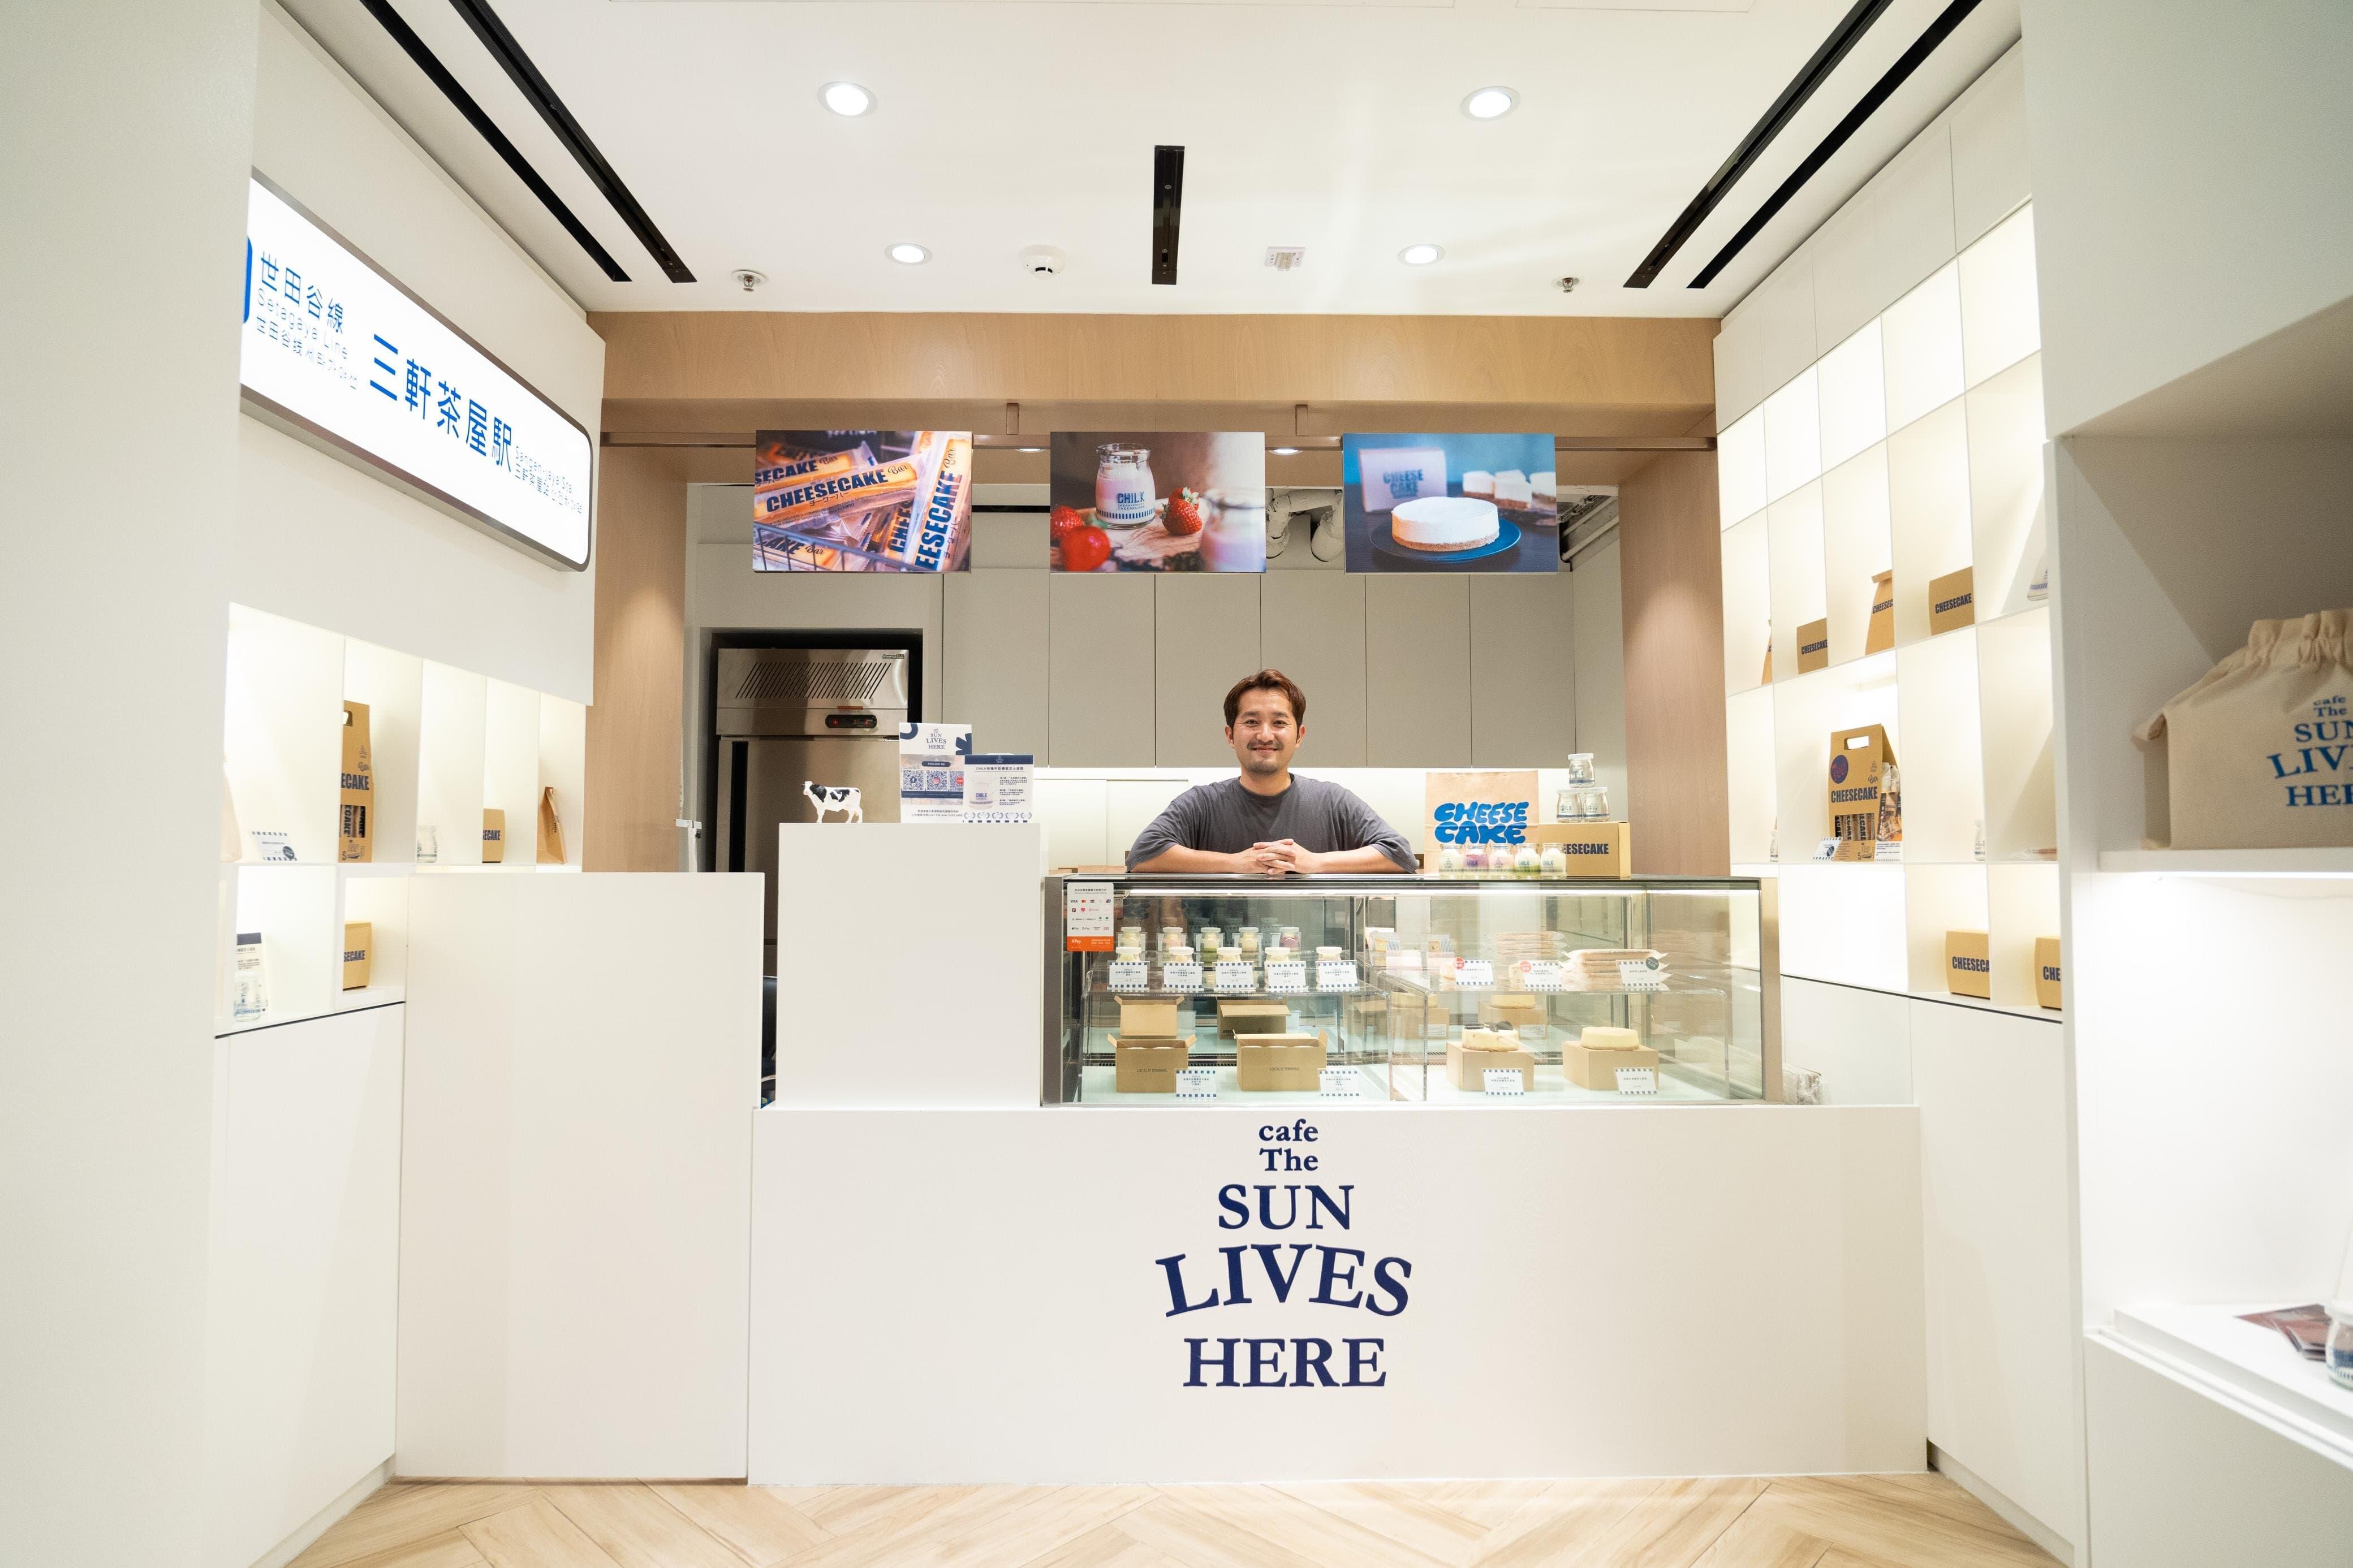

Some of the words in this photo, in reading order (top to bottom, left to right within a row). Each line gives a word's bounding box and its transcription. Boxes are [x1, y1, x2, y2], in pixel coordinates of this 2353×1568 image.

[261, 251, 343, 334] 世田谷線
[257, 288, 318, 340] Setagaya
[324, 331, 348, 360] Line
[369, 333, 512, 473] 三軒茶屋駅
[819, 455, 838, 466] Bar
[943, 447, 956, 469] Bar
[1382, 469, 1424, 484] CHEESE
[766, 469, 889, 513] CHEESECAKE
[887, 464, 909, 475] Bar
[1117, 491, 1145, 504] CHILK
[1390, 481, 1419, 499] CAKE
[805, 545, 824, 555] Bar
[1935, 593, 1972, 614] CHEESECAKE
[2313, 695, 2346, 706] cafe
[2313, 706, 2347, 718] The
[341, 772, 369, 791] ECAKE
[1830, 786, 1878, 803] CHEESECAKE
[1434, 801, 1529, 826] CHEESE
[1434, 822, 1527, 844] CAKE
[1564, 843, 1609, 854] ESECAKE
[1259, 1118, 1318, 1142] cafe
[1259, 1147, 1318, 1172] The
[1218, 1183, 1355, 1230] SUN
[1155, 1243, 1412, 1318] LIVES
[1183, 1338, 1386, 1388] HERE
